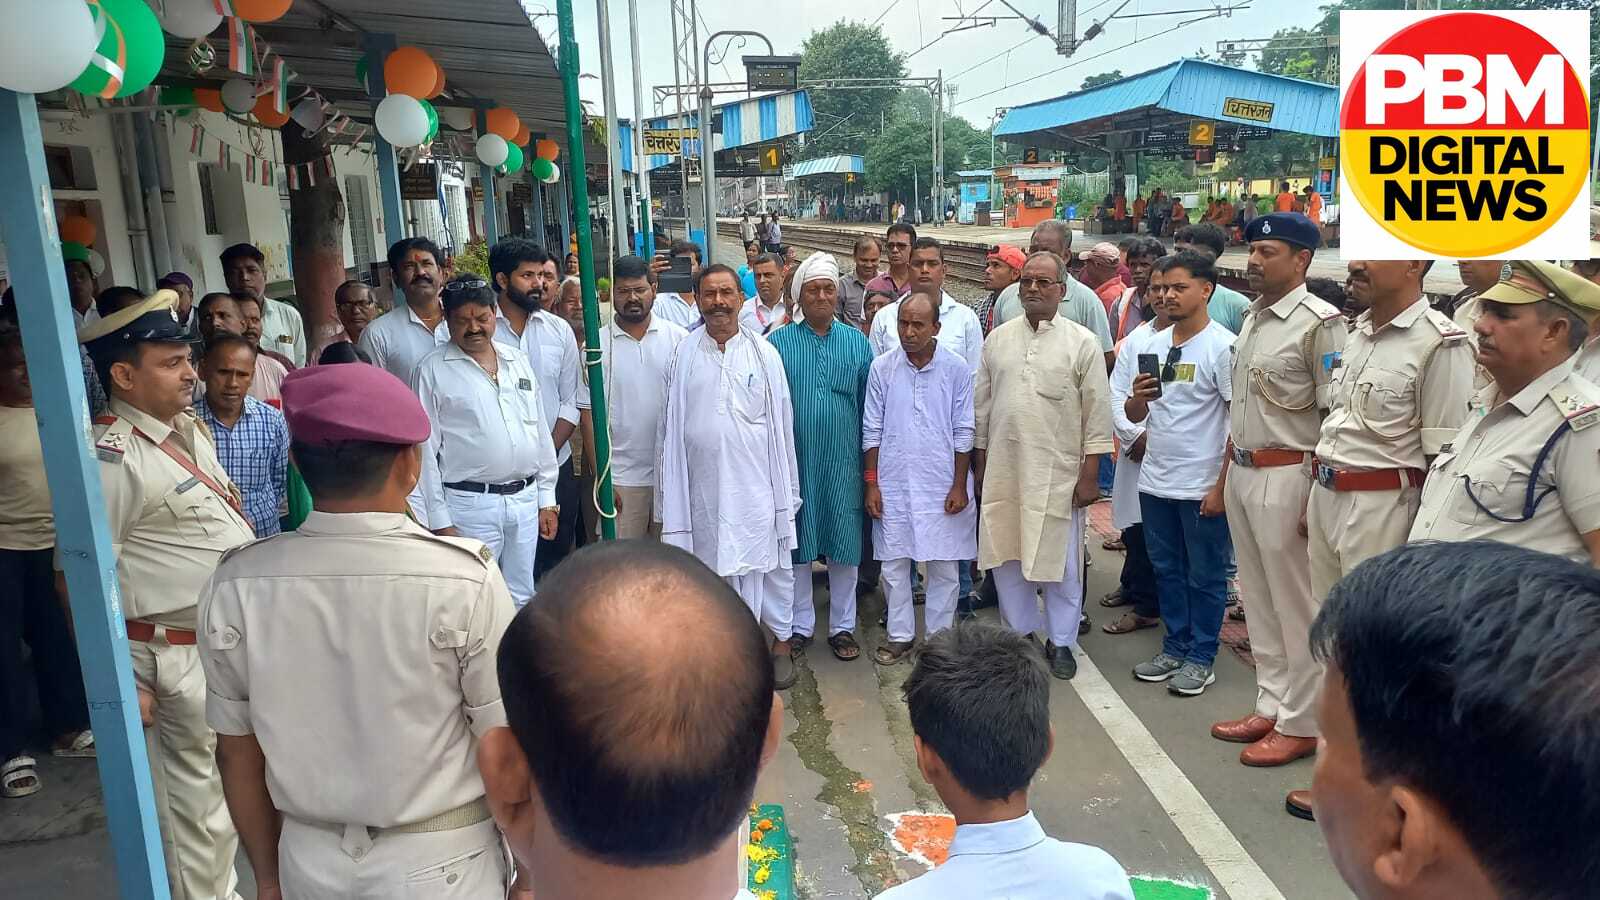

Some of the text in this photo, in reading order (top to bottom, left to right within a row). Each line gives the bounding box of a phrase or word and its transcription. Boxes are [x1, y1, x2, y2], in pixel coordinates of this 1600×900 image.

[1195, 124, 1209, 141] 2
[766, 148, 777, 166] 1
[1027, 151, 1036, 161] 2
